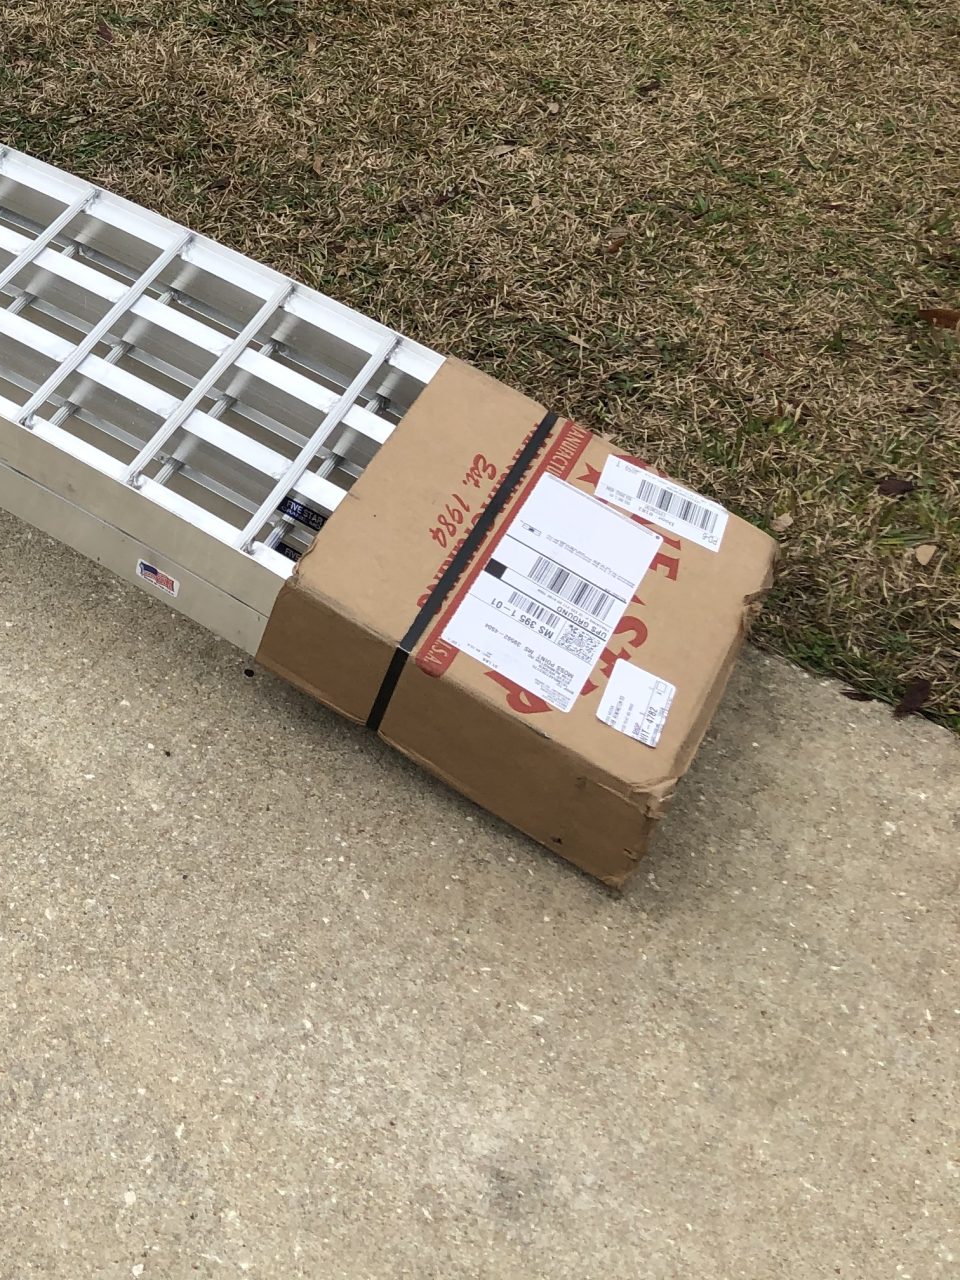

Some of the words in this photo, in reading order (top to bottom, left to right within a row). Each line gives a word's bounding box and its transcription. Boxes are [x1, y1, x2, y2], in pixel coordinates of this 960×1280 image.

[462, 453, 497, 488] Est.
[287, 500, 303, 513] FIVE
[428, 493, 470, 548] 1984
[517, 613, 537, 629] 395
[555, 605, 589, 628] GROUND
[537, 624, 554, 639] MS
[590, 625, 607, 638] UPS
